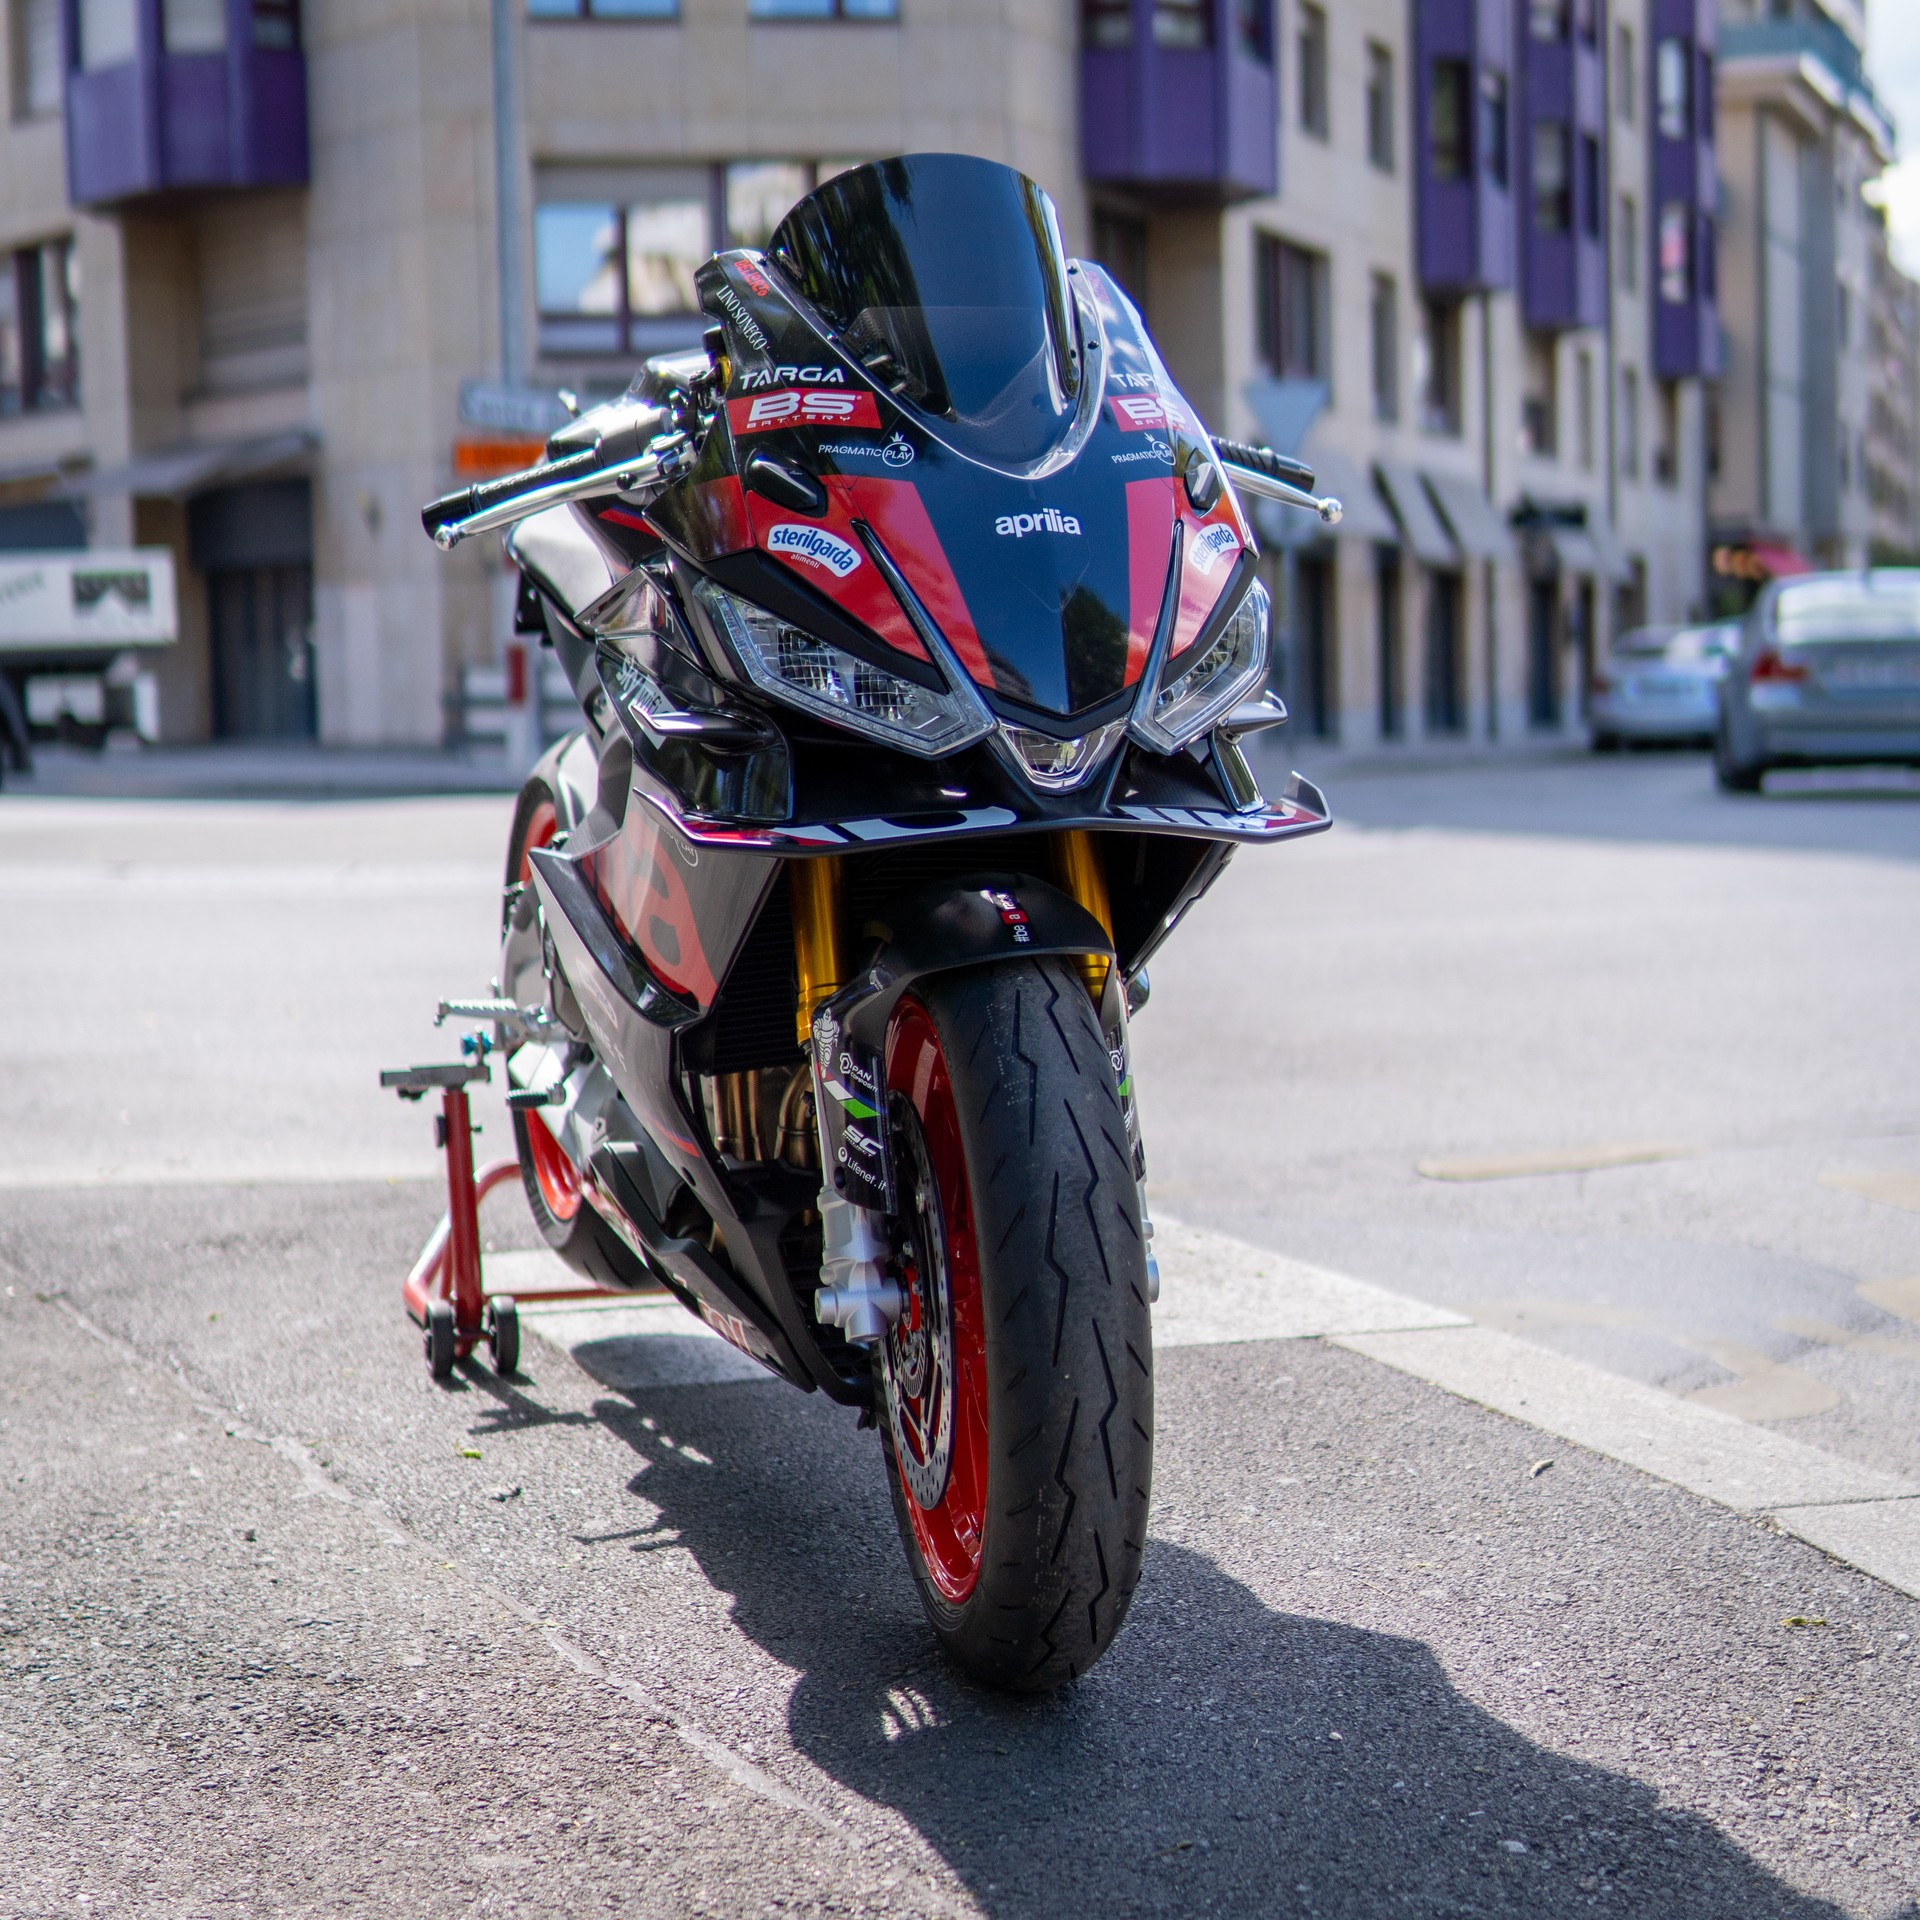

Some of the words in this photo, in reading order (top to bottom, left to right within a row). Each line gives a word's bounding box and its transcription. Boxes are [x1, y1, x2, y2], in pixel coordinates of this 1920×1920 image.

[716, 285, 737, 313] LINO
[733, 305, 768, 351] SONEGO
[739, 366, 845, 390] TARGA
[749, 391, 857, 422] BS
[746, 414, 851, 429] BATTERY
[818, 444, 882, 457] PRAGMATIC
[885, 449, 912, 461] PLAY
[1111, 450, 1156, 463] PRAGMATIC
[995, 507, 1082, 538] aprilia
[772, 528, 854, 571] sterilgarda
[1193, 525, 1235, 570] sterilgarda
[790, 553, 821, 569] alimenti
[1013, 924, 1030, 942] #be
[850, 1072, 879, 1093] COMPOSITI
[851, 1065, 872, 1081] PAN
[843, 1124, 884, 1156] SC
